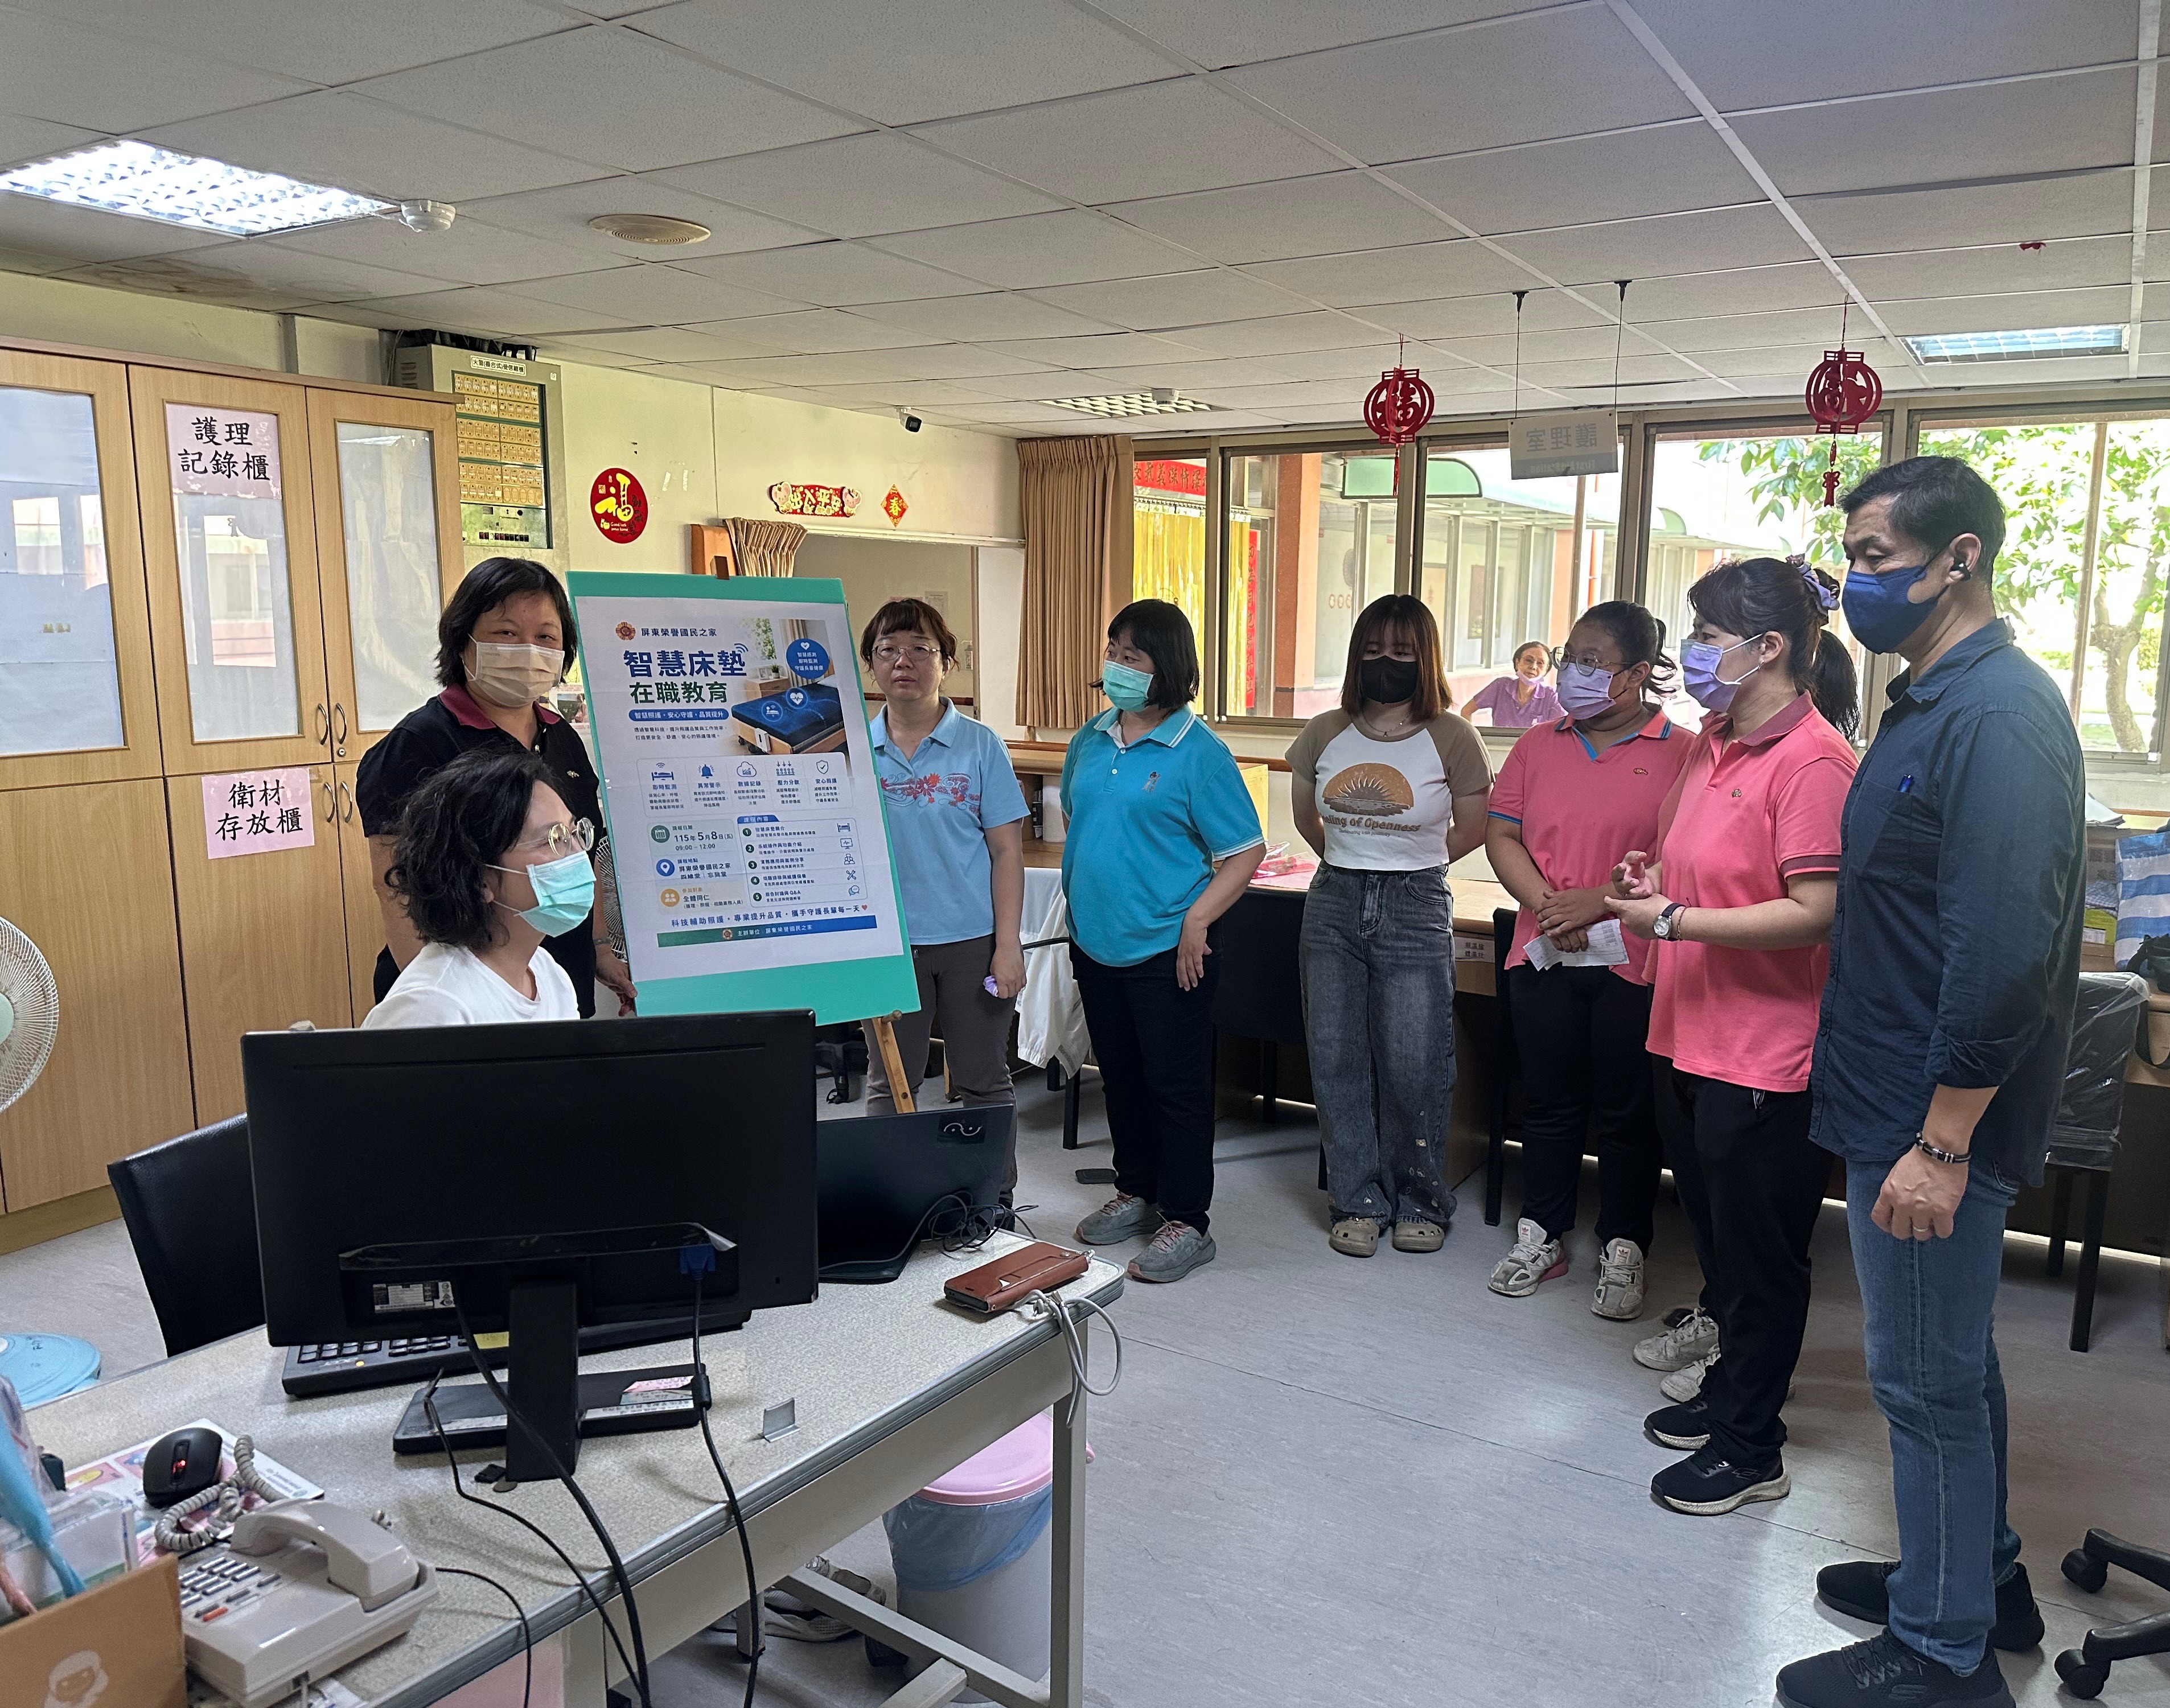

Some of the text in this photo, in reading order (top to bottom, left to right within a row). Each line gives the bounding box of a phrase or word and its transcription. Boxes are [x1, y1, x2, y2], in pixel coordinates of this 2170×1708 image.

[191, 416, 253, 446] 護理
[178, 448, 270, 480] 記錄櫃
[890, 497, 901, 516] 春
[641, 628, 717, 637] 屏東榮譽國民之家
[623, 650, 747, 677] 智慧床墊
[629, 681, 727, 704] 在職教育
[228, 779, 285, 809] 衛材
[215, 806, 303, 841] 存放櫃
[1350, 817, 1363, 827] of
[1365, 817, 1421, 832] Openness
[679, 862, 731, 872] 屏東榮譽國民之家
[683, 894, 710, 903] 全體同仁
